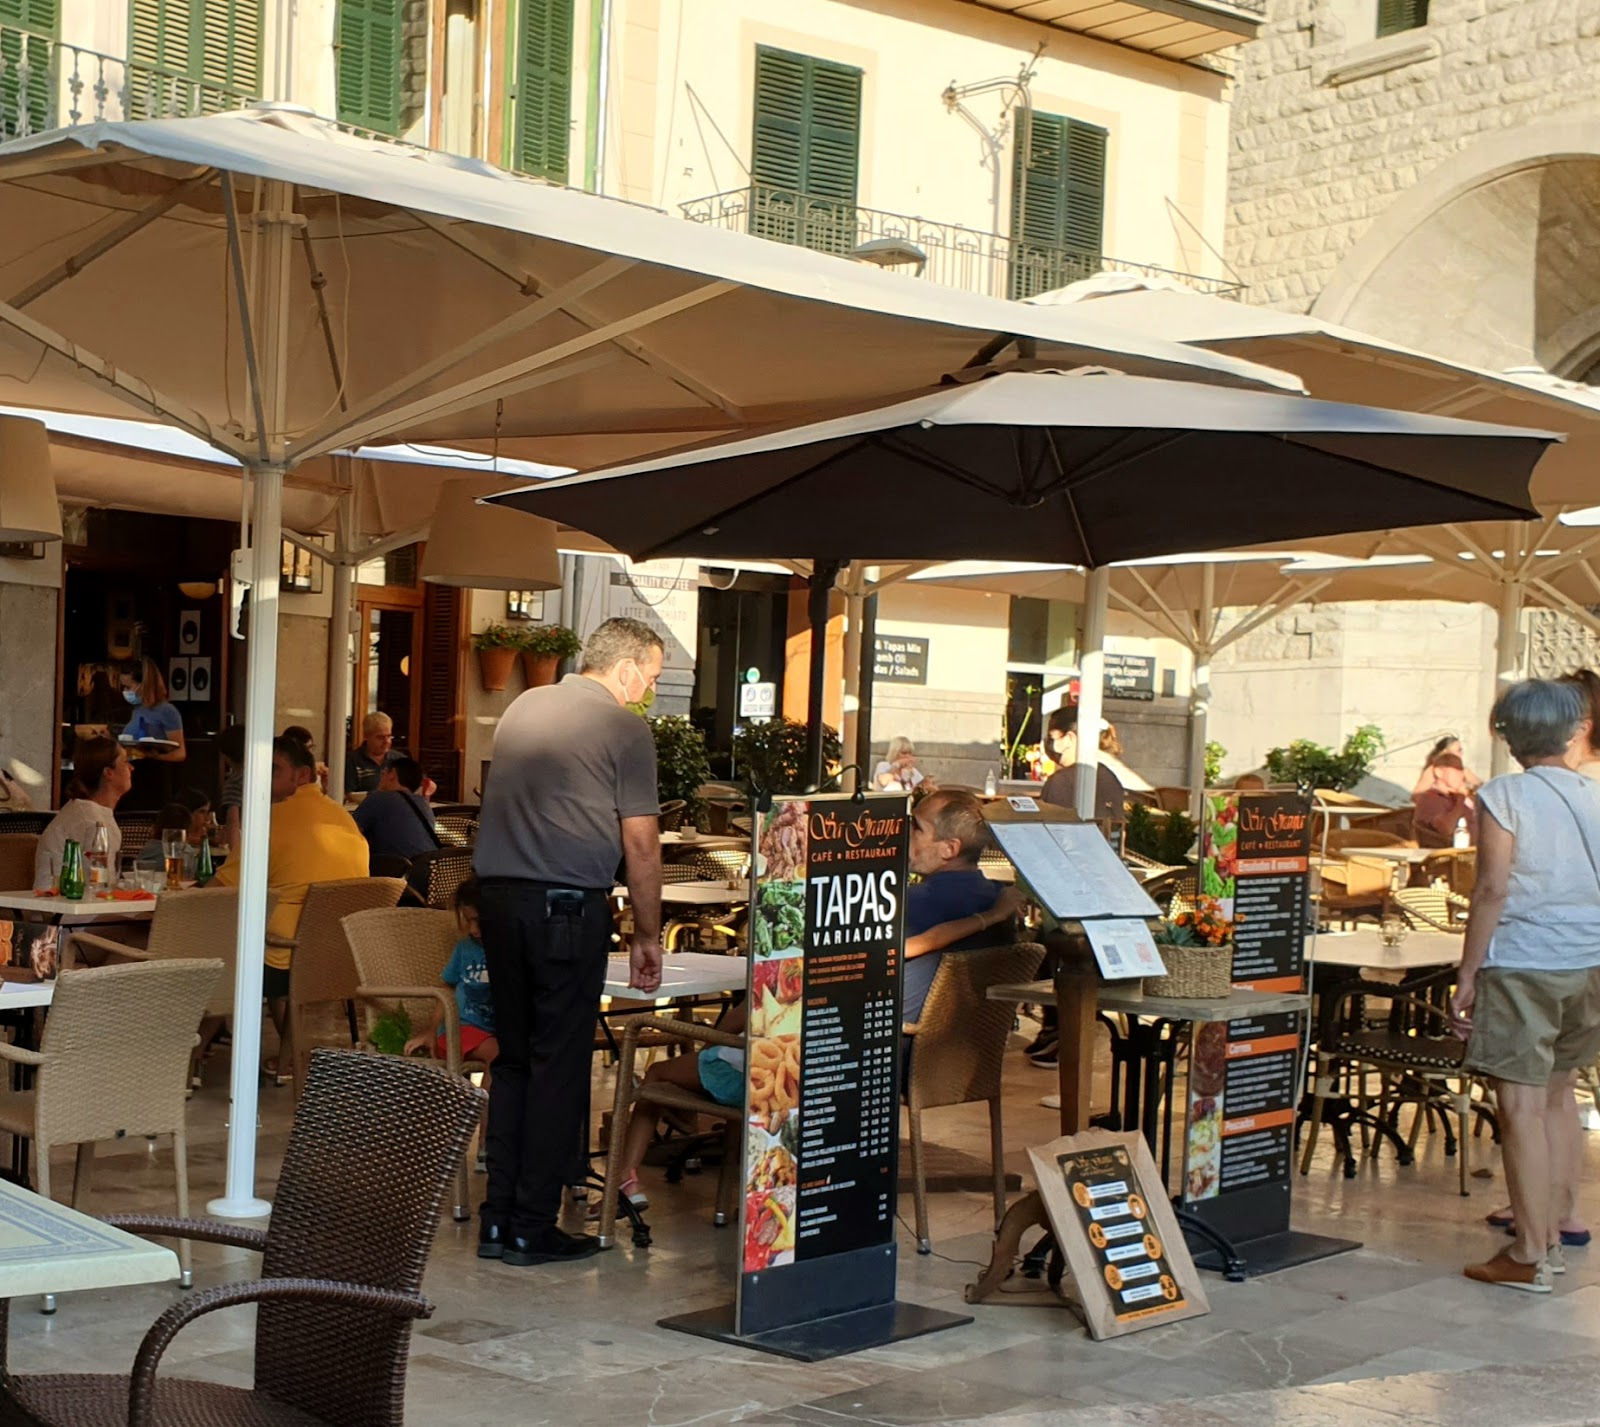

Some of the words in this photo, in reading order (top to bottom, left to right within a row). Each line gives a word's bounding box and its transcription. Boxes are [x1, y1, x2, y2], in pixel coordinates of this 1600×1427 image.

[845, 846, 897, 860] RESTAURANT
[810, 869, 897, 928] TAPAS
[812, 924, 893, 947] VARIADAS
